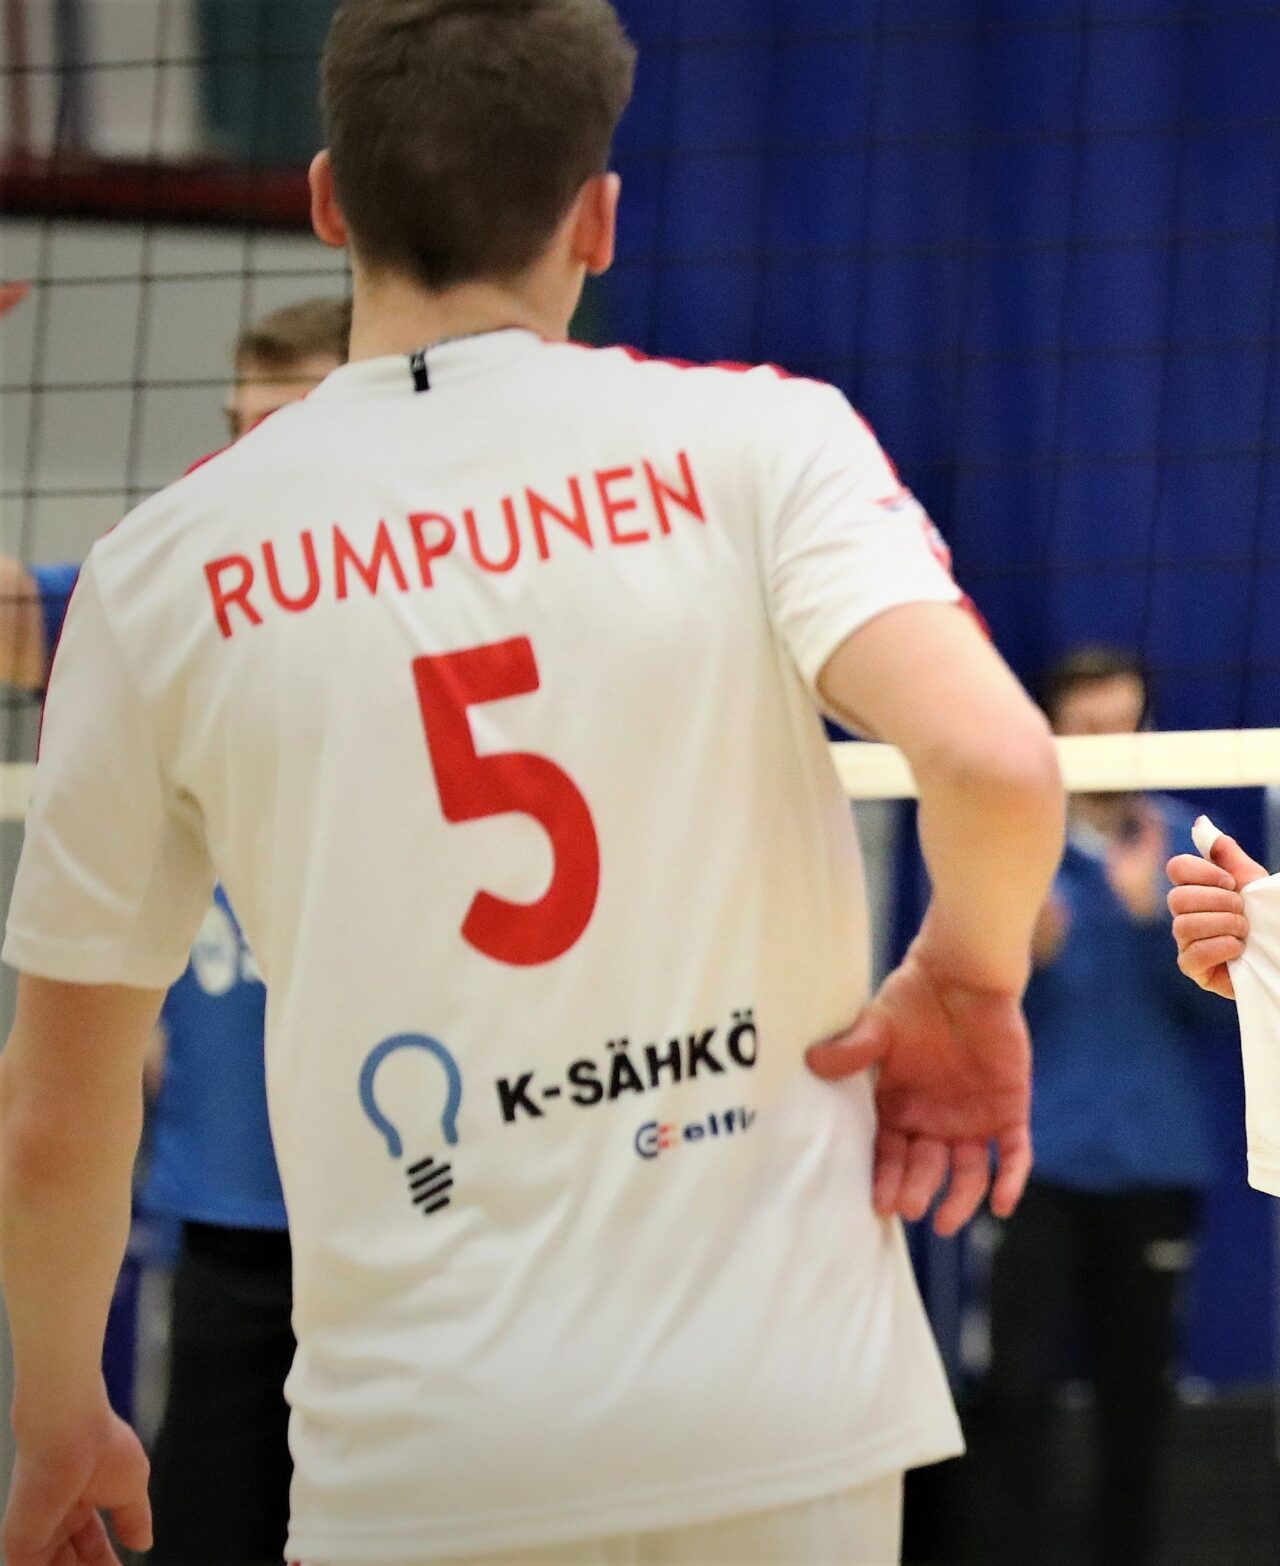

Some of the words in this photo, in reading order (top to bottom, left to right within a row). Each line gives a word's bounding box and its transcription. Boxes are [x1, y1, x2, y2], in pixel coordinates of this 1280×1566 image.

[203, 449, 707, 639] RUMPUNEN
[411, 634, 601, 969] 5
[496, 1006, 757, 1124] K-SÄHKÖ
